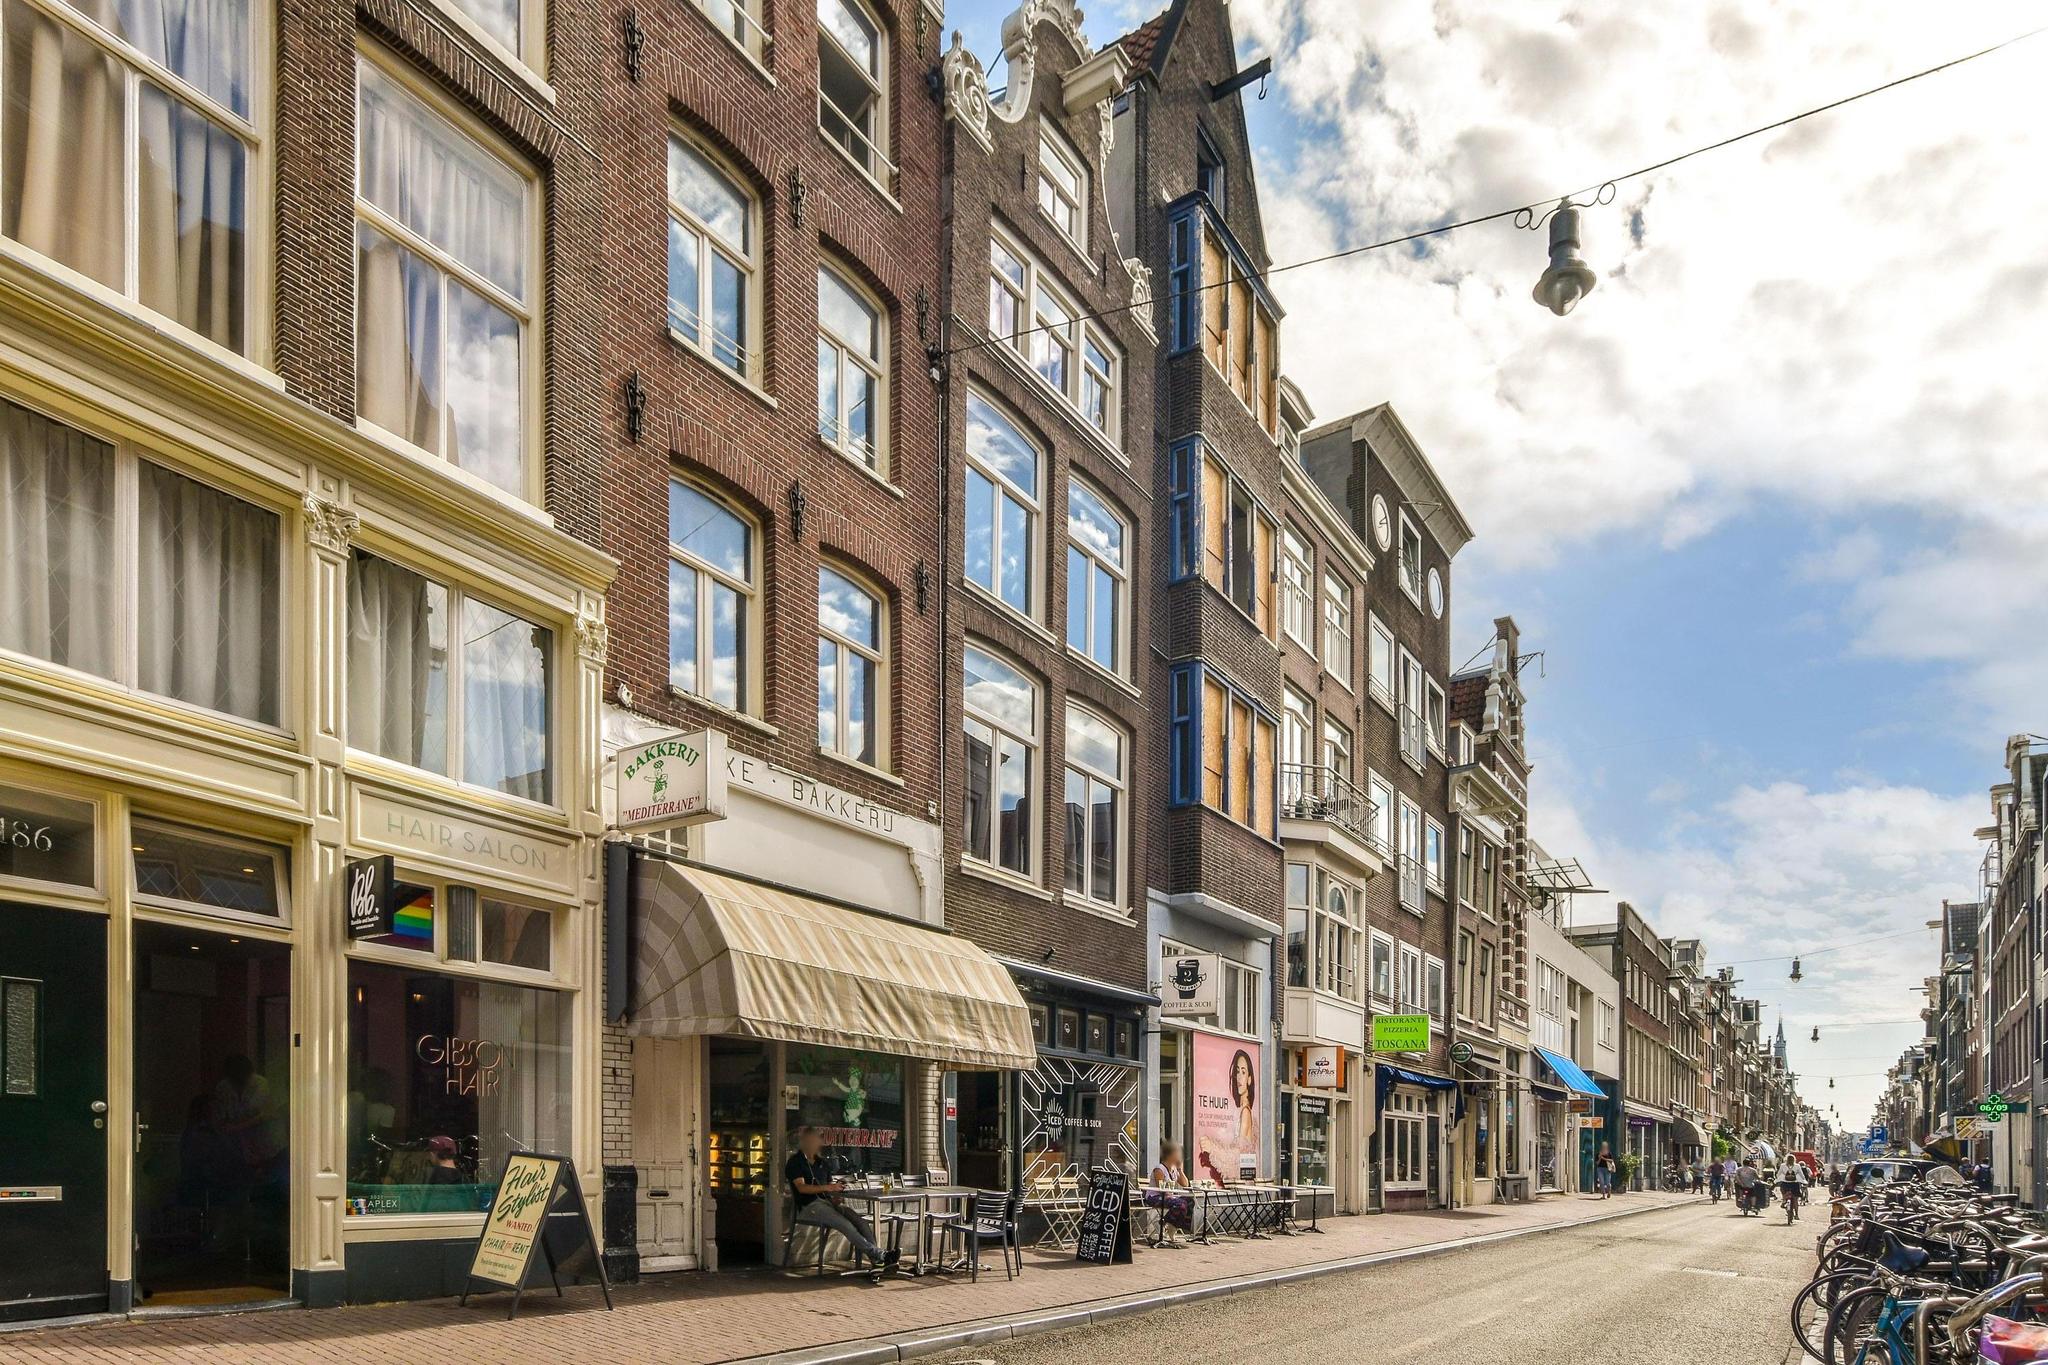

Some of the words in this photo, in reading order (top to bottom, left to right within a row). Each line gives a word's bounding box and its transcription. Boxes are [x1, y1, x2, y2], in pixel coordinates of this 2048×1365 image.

[624, 742, 700, 780] BAKKERIJ
[792, 779, 893, 832] BAKKERIJ
[387, 812, 452, 849] HAIR
[463, 831, 547, 871] SALON
[1163, 1001, 1188, 1009] COFFEE
[416, 1034, 516, 1069] GIBSON
[1375, 1040, 1427, 1049] TOSCANA
[446, 1067, 500, 1096] HAIR
[1199, 1094, 1208, 1108] TE
[1209, 1096, 1229, 1110] HUUR
[1979, 1104, 2008, 1112] 06/09
[1047, 1113, 1062, 1126] ICED
[1064, 1118, 1083, 1126] COFFEE
[1090, 1120, 1102, 1128] SUCH
[1873, 1128, 1882, 1138] P
[506, 1160, 547, 1195] Hair
[496, 1182, 551, 1222] Stylist
[484, 1238, 506, 1251] CHAIR
[511, 1243, 531, 1256] RENT
[1097, 1214, 1117, 1258] COFFEE
